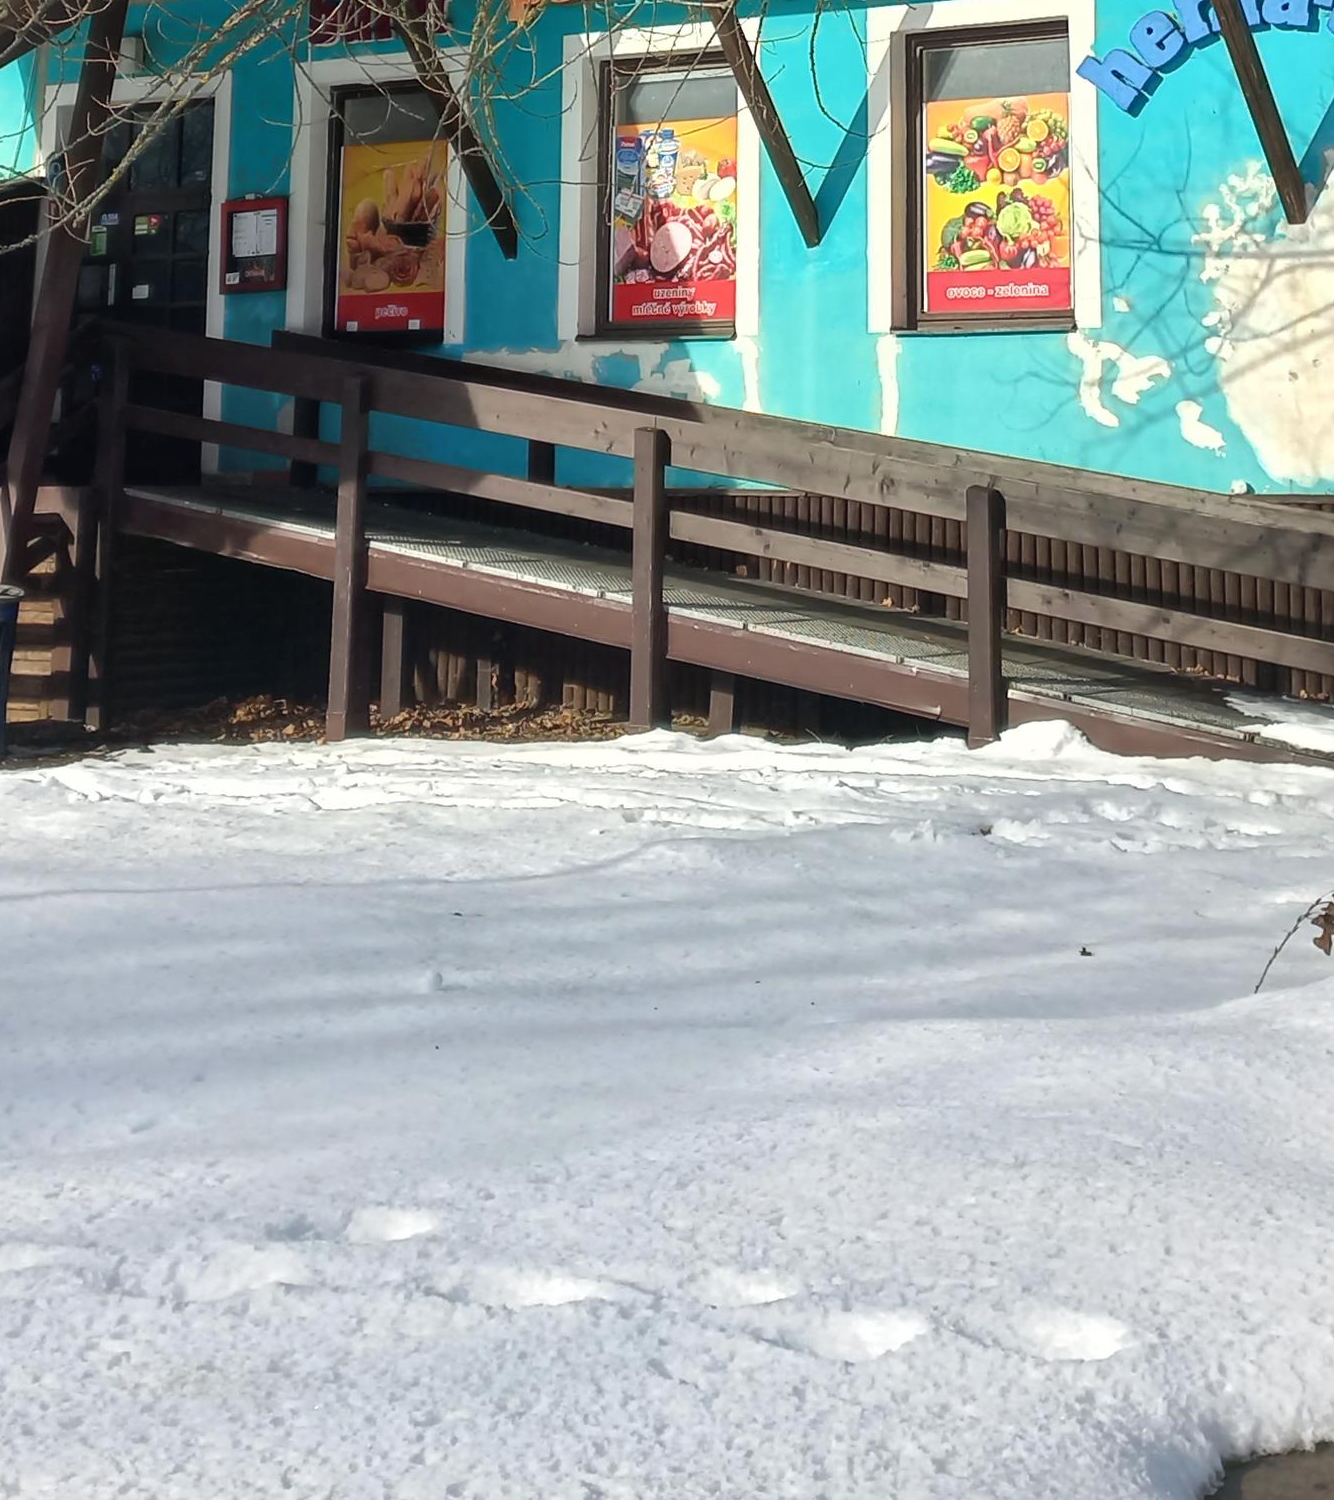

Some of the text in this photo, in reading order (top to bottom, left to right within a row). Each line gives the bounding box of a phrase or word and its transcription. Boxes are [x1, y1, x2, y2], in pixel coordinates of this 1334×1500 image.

[652, 286, 696, 301] uzeniny
[946, 285, 986, 299] ovoce
[995, 282, 1049, 298] zelenina
[375, 304, 408, 320] pečivo
[672, 300, 716, 317] výrobky
